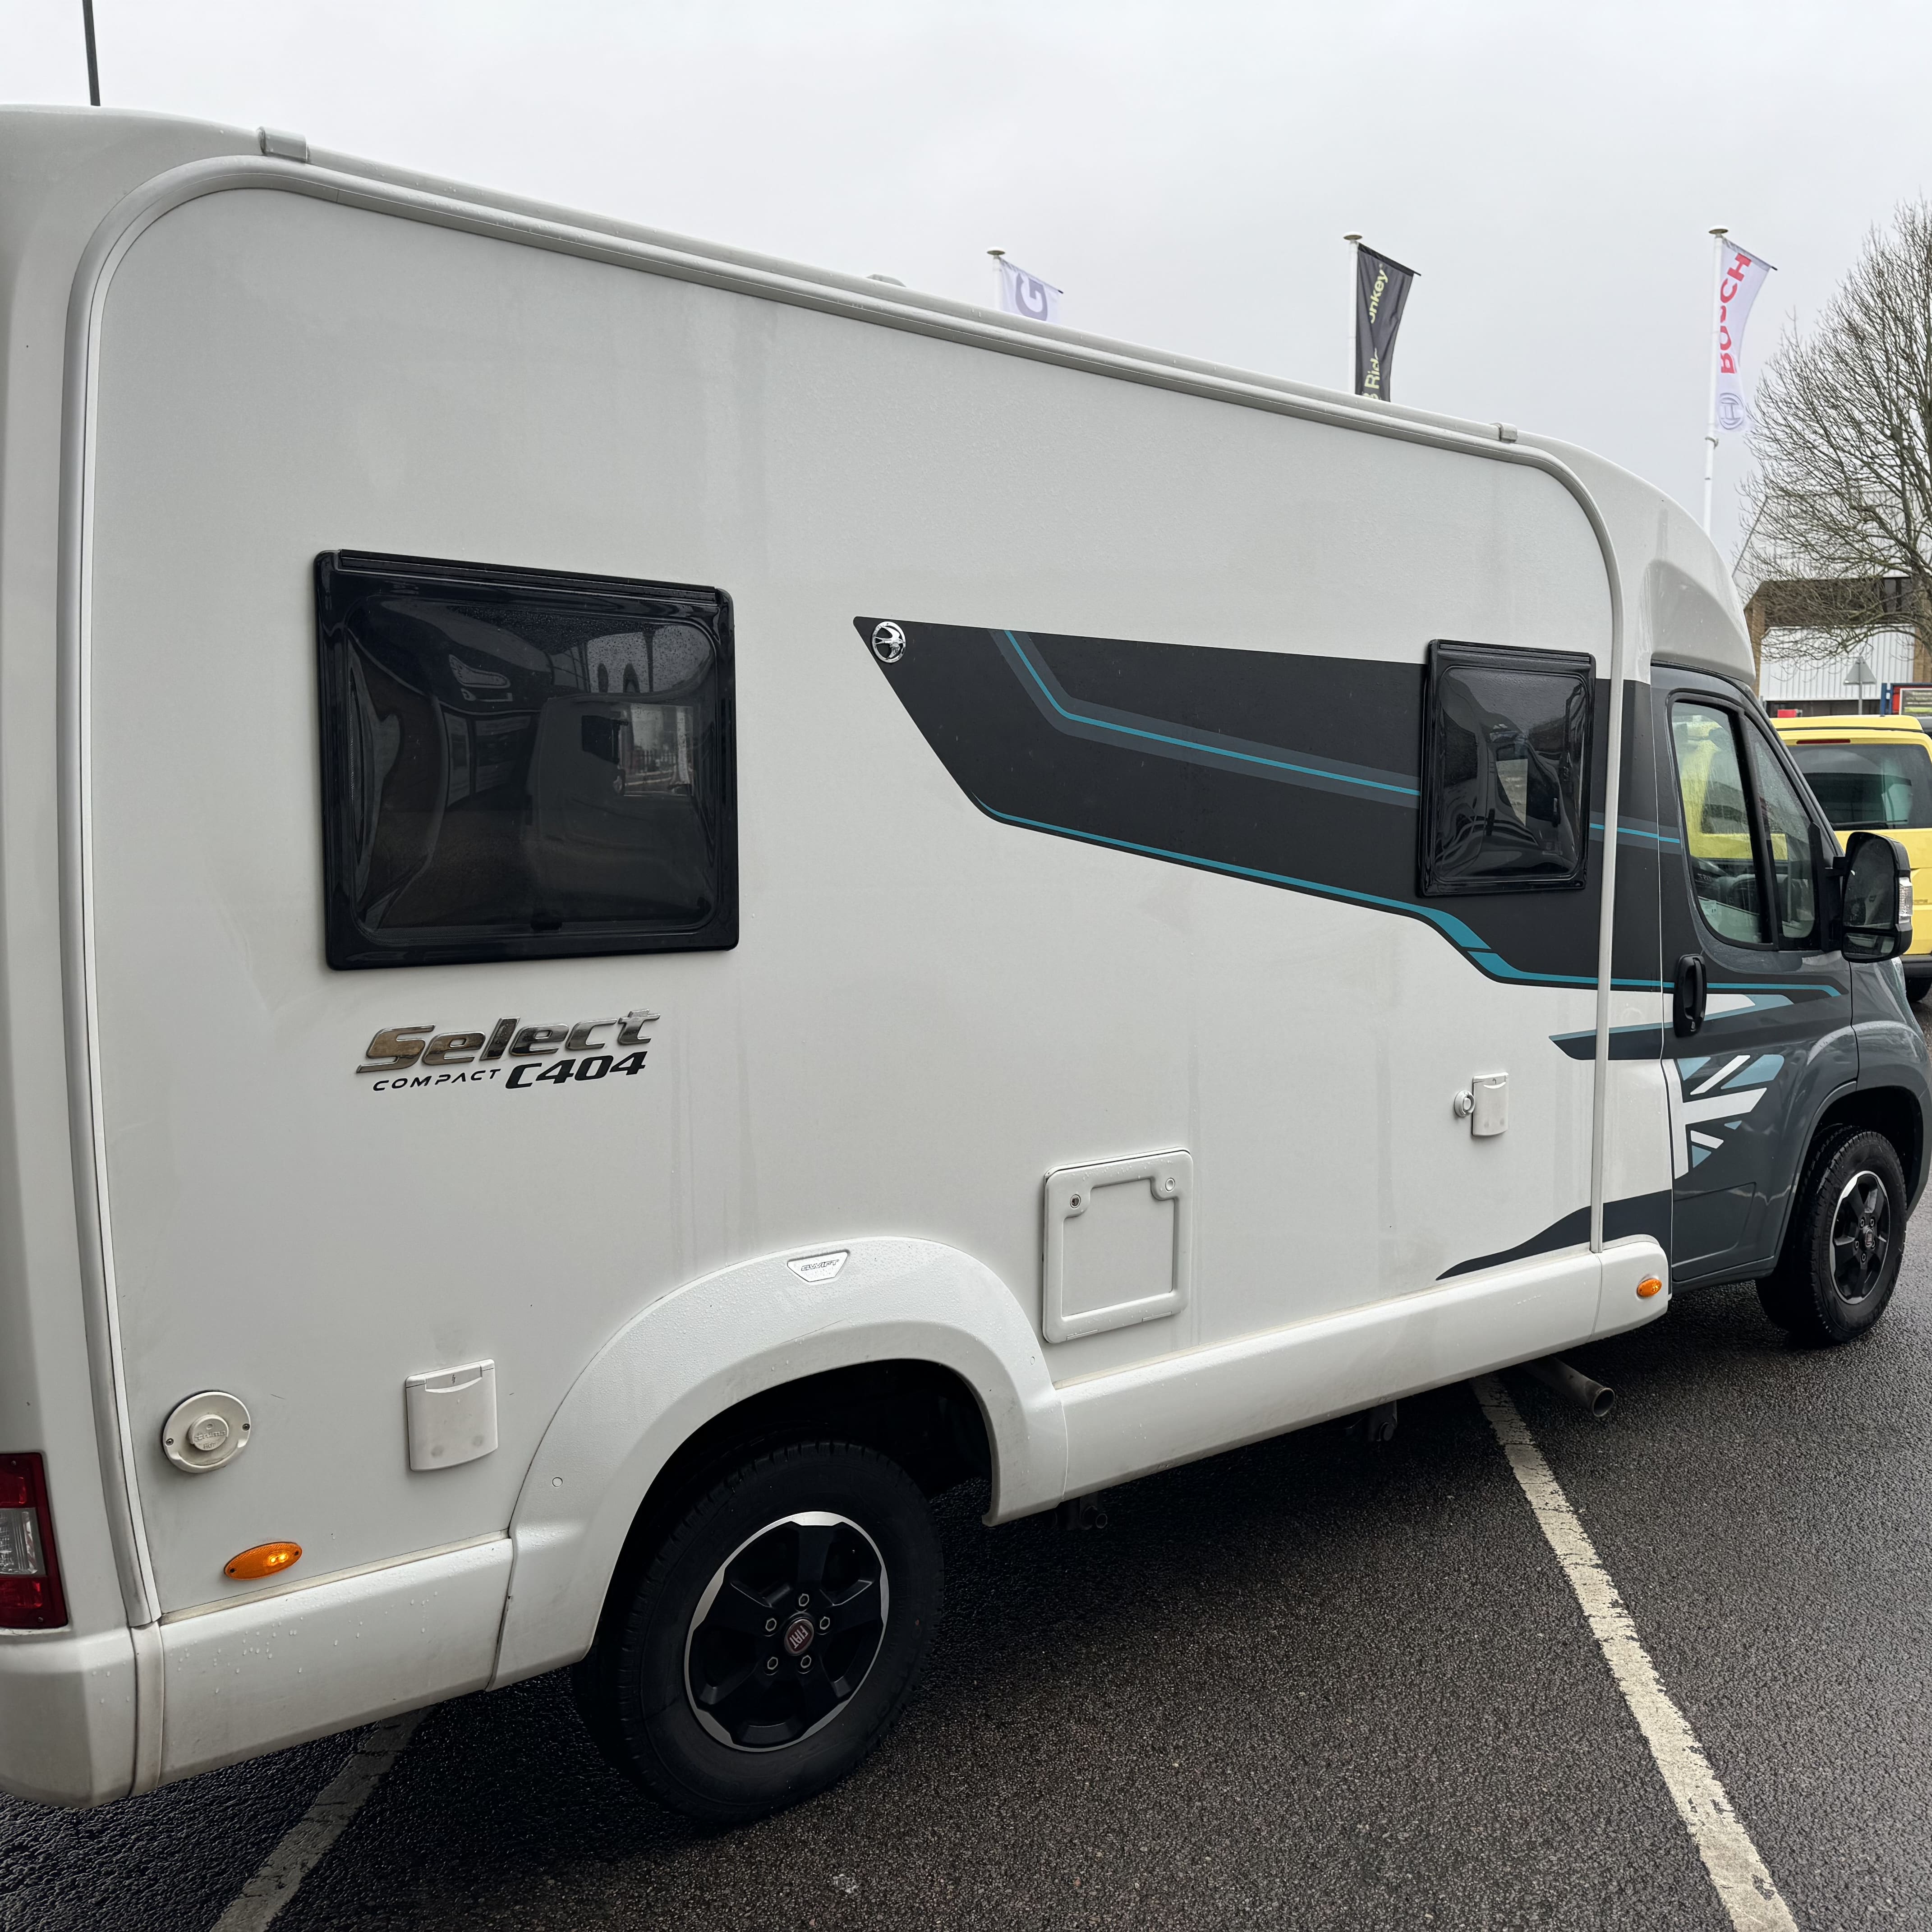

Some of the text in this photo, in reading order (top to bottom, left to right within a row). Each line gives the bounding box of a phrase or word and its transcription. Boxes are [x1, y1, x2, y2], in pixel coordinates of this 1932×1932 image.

[356, 1009, 660, 1073] Select
[373, 1051, 647, 1091] COMPACT C404
[801, 1260, 839, 1271] SWIFT
[790, 1625, 809, 1649] FIAT
